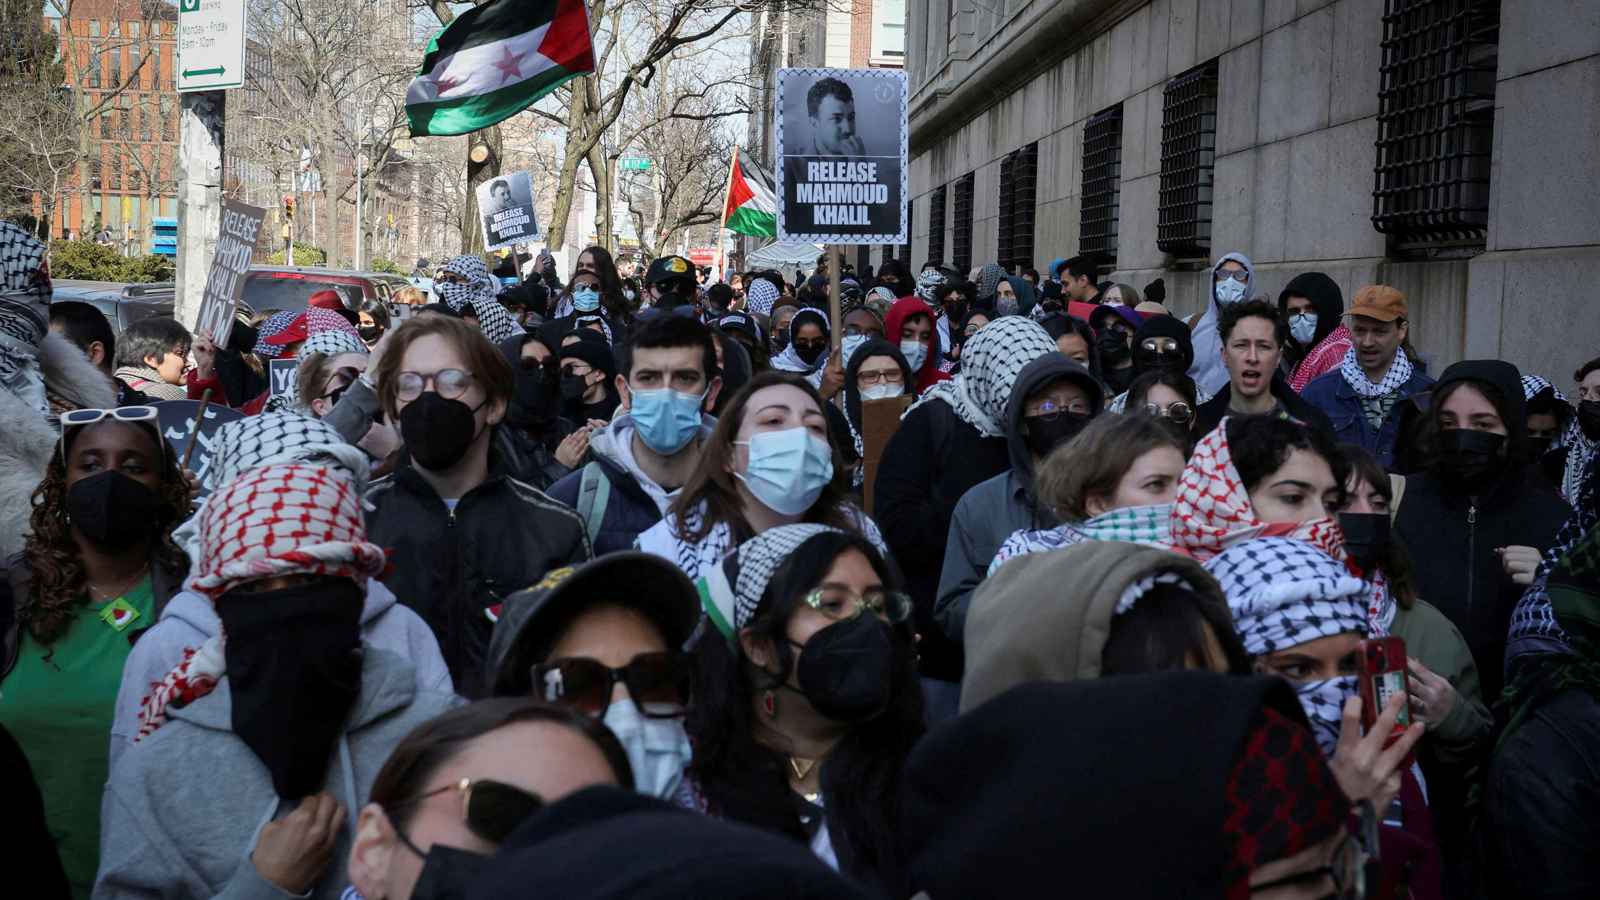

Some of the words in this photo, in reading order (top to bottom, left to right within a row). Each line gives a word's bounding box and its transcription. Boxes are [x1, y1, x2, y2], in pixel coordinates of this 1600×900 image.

[807, 161, 877, 182] RELEASE
[796, 183, 888, 204] MAHMOUD
[490, 214, 530, 233] MAHMOUD
[493, 207, 524, 222] RELEASE
[813, 205, 871, 225] KHALIL
[222, 208, 262, 244] RELEASE
[498, 225, 525, 239] KHALIL
[206, 263, 239, 305] KHALIL
[200, 294, 237, 347] NOW
